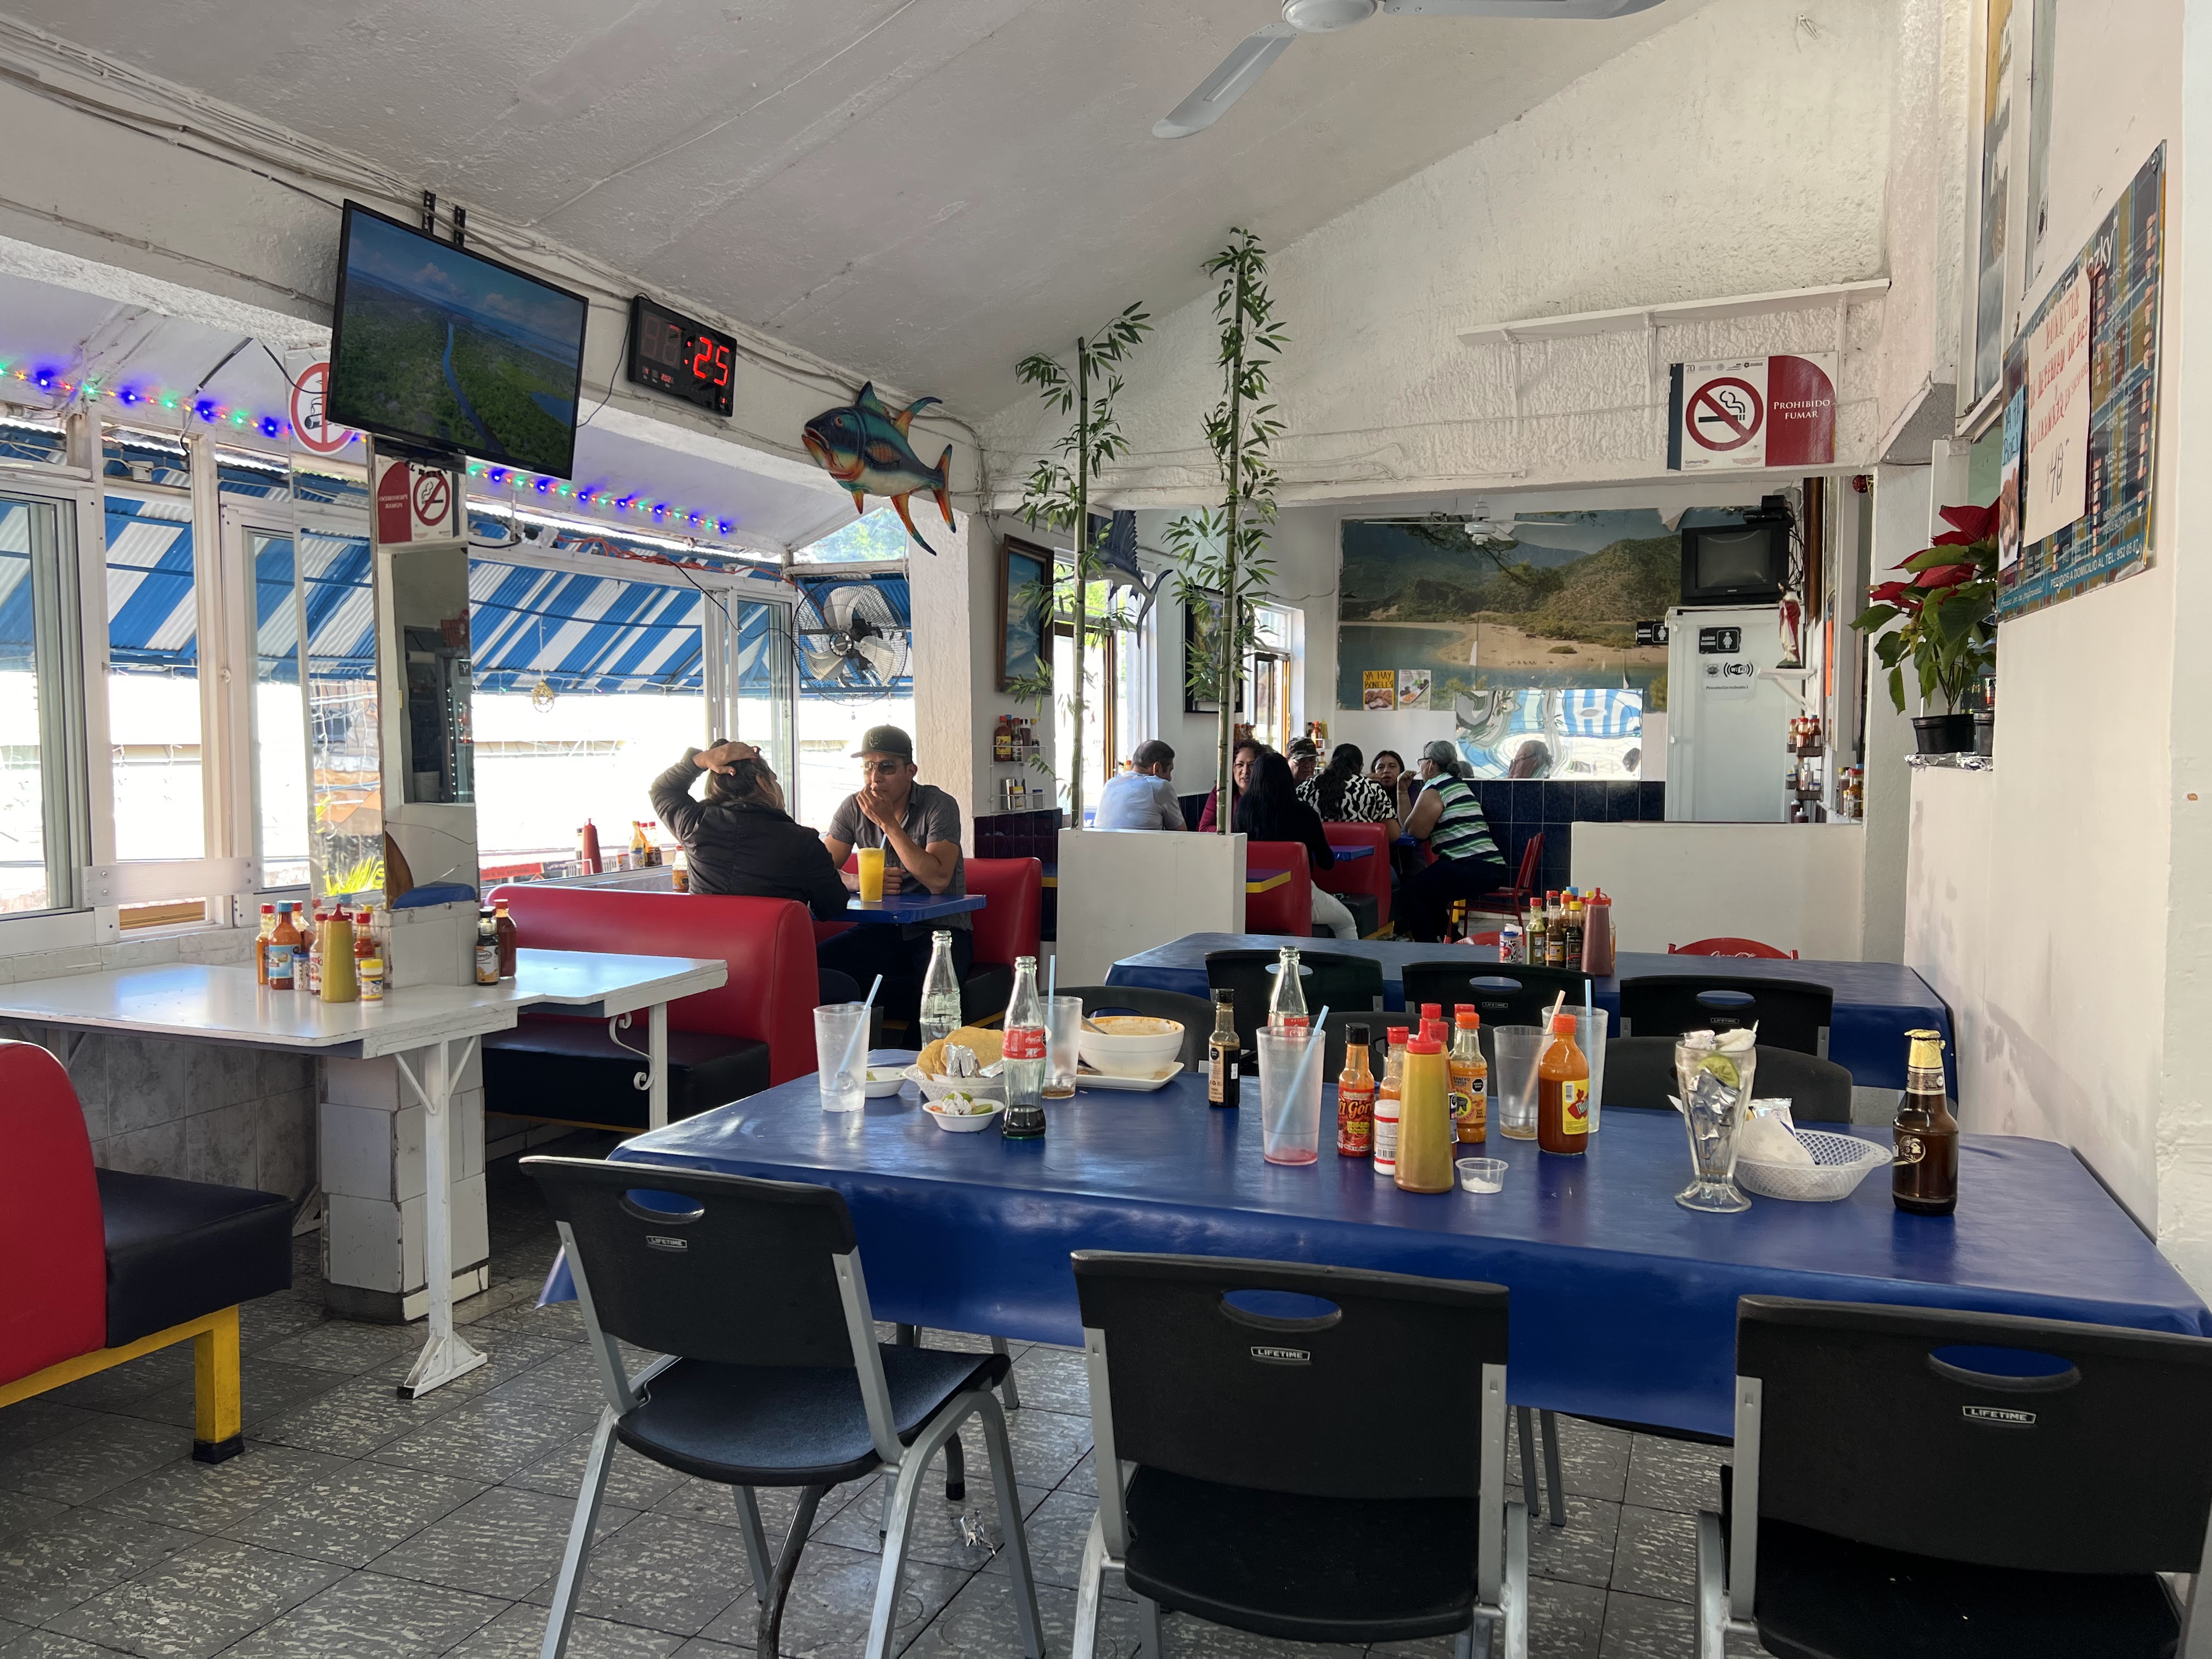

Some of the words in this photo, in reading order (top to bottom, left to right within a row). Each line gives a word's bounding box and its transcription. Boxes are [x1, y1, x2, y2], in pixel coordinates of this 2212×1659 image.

[2045, 292, 2080, 351] BURRITOS
[1774, 399, 1830, 409] PROHIBIDO
[1785, 411, 1818, 420] FUMAR
[2074, 559, 2097, 579] DOMICILIO
[2098, 556, 2104, 569] AL
[1364, 672, 1374, 681] YA
[1378, 671, 1391, 681] HAY
[651, 1237, 684, 1246] LIFETIME
[1258, 1348, 1304, 1358] LIFETIME
[1971, 1408, 2028, 1421] LIFETIME
